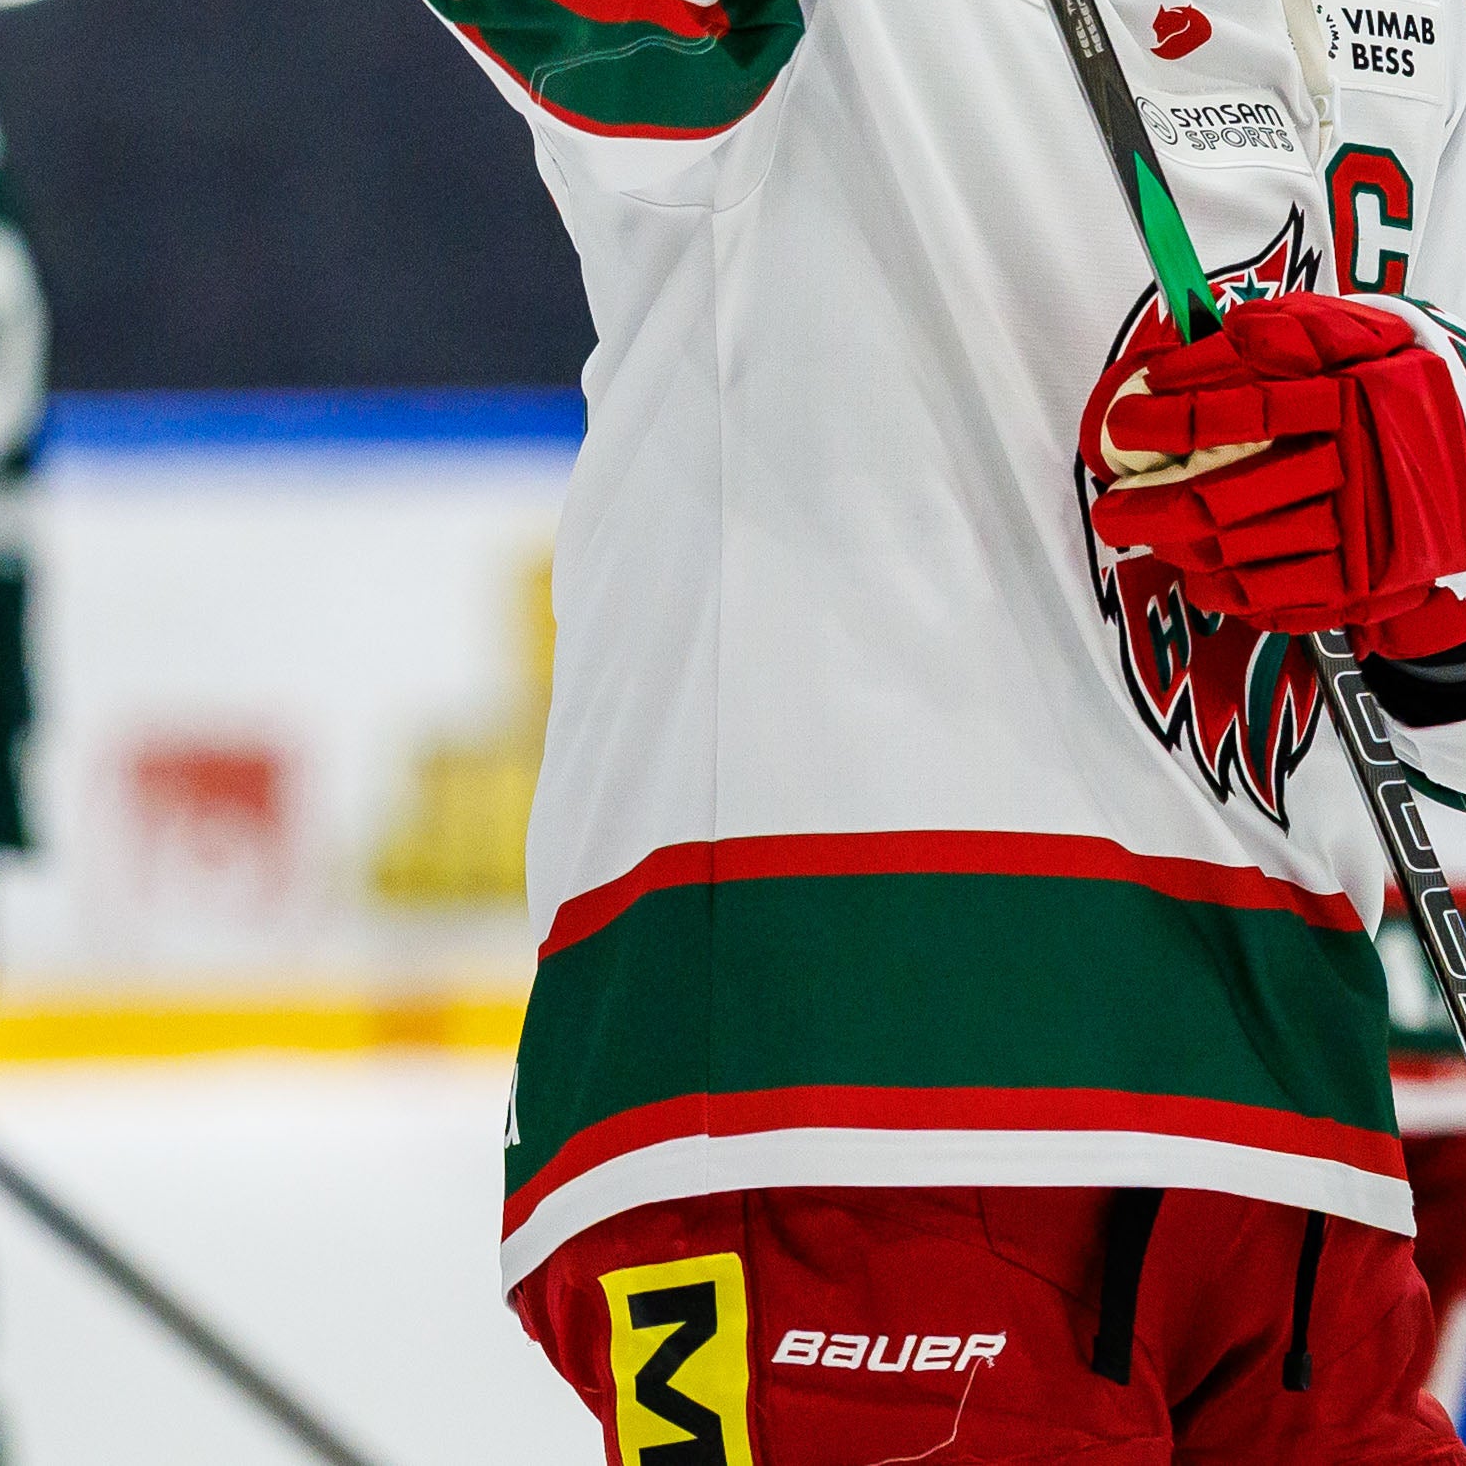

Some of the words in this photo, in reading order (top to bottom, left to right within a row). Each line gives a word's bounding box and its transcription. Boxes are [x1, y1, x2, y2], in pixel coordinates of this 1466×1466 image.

[1075, 19, 1093, 59] FEEL
[1325, 14, 1340, 60] VIMAB
[1341, 7, 1436, 46] VIMAB
[1351, 42, 1416, 78] BESS
[1170, 102, 1285, 129] SYNSAM
[1184, 126, 1295, 153] SPORTS
[1325, 142, 1413, 297] C
[771, 1329, 1007, 1373] BAUER
